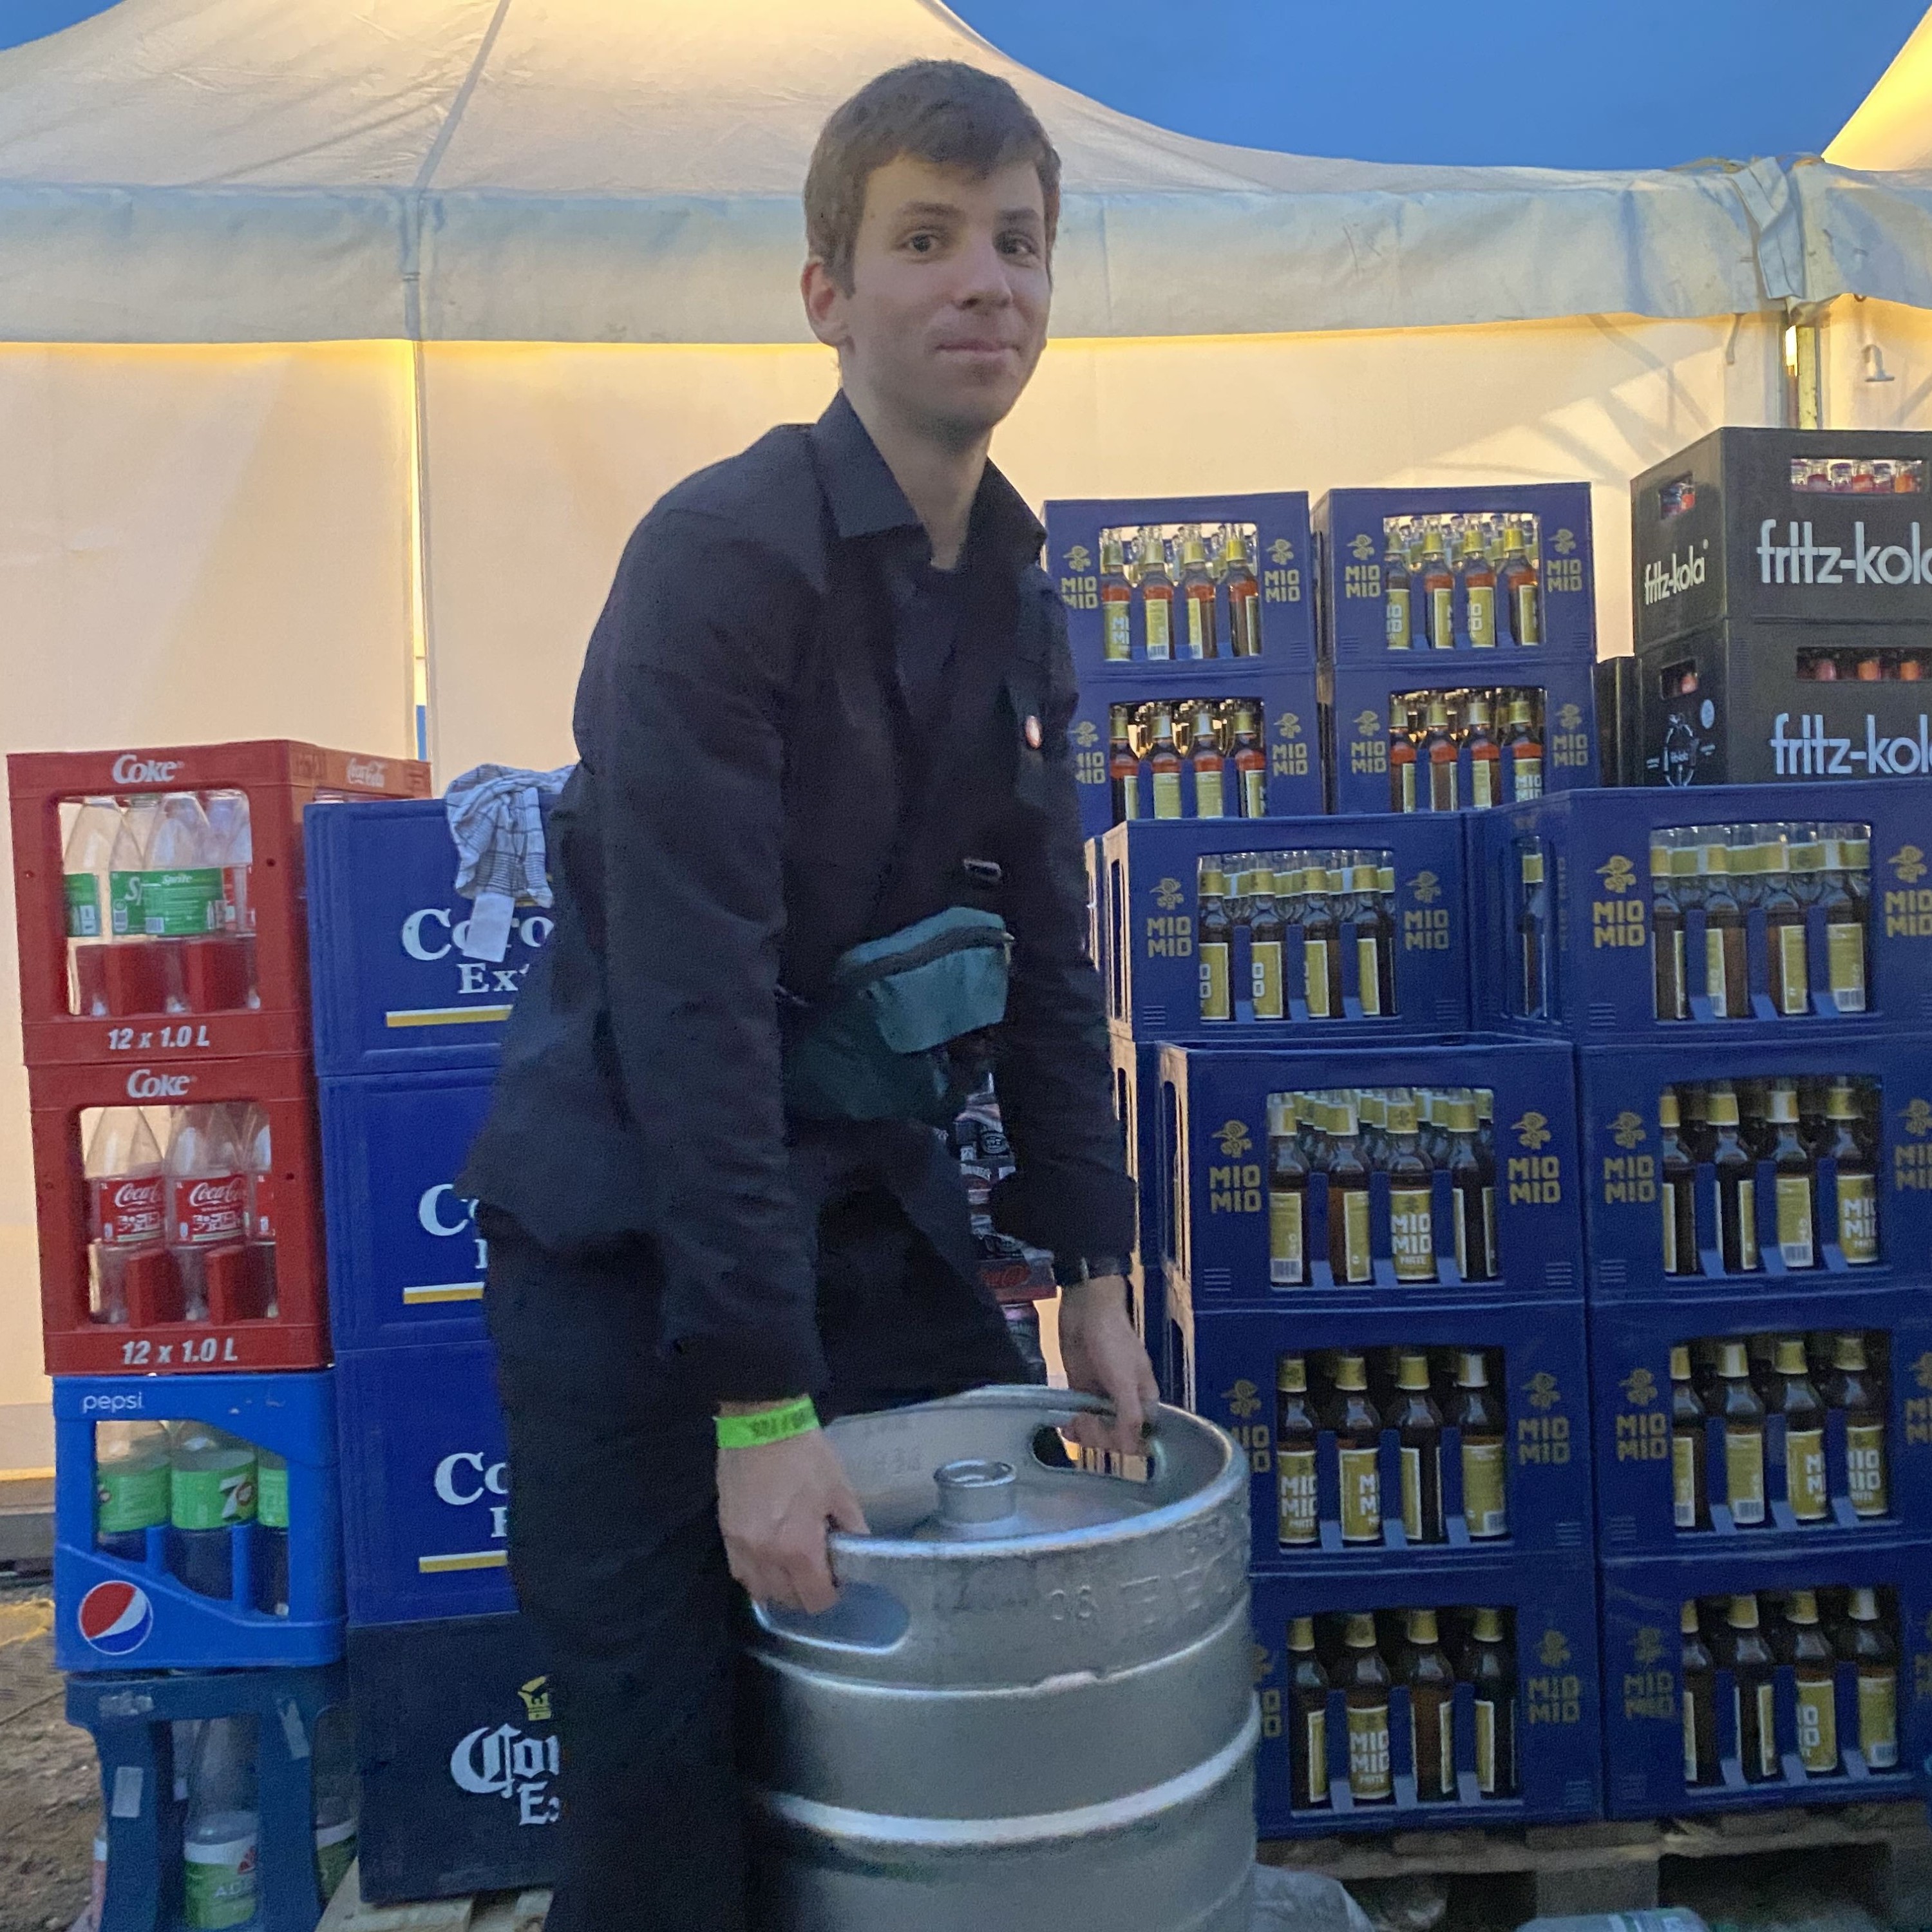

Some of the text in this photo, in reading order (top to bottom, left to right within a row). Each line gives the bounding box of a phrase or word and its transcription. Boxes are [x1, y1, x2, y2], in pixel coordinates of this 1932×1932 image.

[1265, 569, 1300, 587] MIO
[1345, 565, 1380, 582] MIO
[1547, 559, 1582, 576] MIO
[1645, 545, 1705, 605] fritz-kola
[1061, 576, 1097, 592] MIO
[1265, 586, 1300, 603] MIO
[1345, 582, 1381, 599] MIO
[1548, 576, 1583, 593] MIO
[1273, 743, 1307, 760] MIO
[1352, 741, 1386, 758] MIO
[1553, 734, 1588, 750] MIO
[1770, 712, 1932, 774] fritz-kol
[113, 754, 176, 784] Coke
[1273, 759, 1308, 776] MIO
[1352, 757, 1387, 774] MIO
[1554, 750, 1589, 767] MIO
[1405, 909, 1449, 929] MIO
[1593, 900, 1644, 925] MIO
[1147, 916, 1191, 937] MIO
[1594, 924, 1645, 949] MIO
[1148, 936, 1191, 958] MIO
[1405, 929, 1450, 951] MIO
[108, 1026, 210, 1050] 12 x 1.0 L
[127, 1069, 192, 1099] Coke
[1209, 1164, 1260, 1189] MIO
[1508, 1156, 1559, 1181] MIO
[1604, 1155, 1654, 1180] MIO
[1211, 1189, 1261, 1214] MIO
[1509, 1180, 1561, 1205] MIO
[1604, 1180, 1656, 1204] MIO
[1392, 1213, 1431, 1233] MIO
[1392, 1234, 1432, 1255] MIO
[122, 1338, 238, 1365] 12 x 1.0 L
[82, 1392, 143, 1414] pepsi
[1517, 1416, 1569, 1441] MIO
[1616, 1412, 1666, 1437] MIO
[1519, 1441, 1570, 1465] MIO
[1617, 1437, 1669, 1462] MIO
[1528, 1676, 1580, 1700] MIO
[1529, 1700, 1580, 1724] MIO
